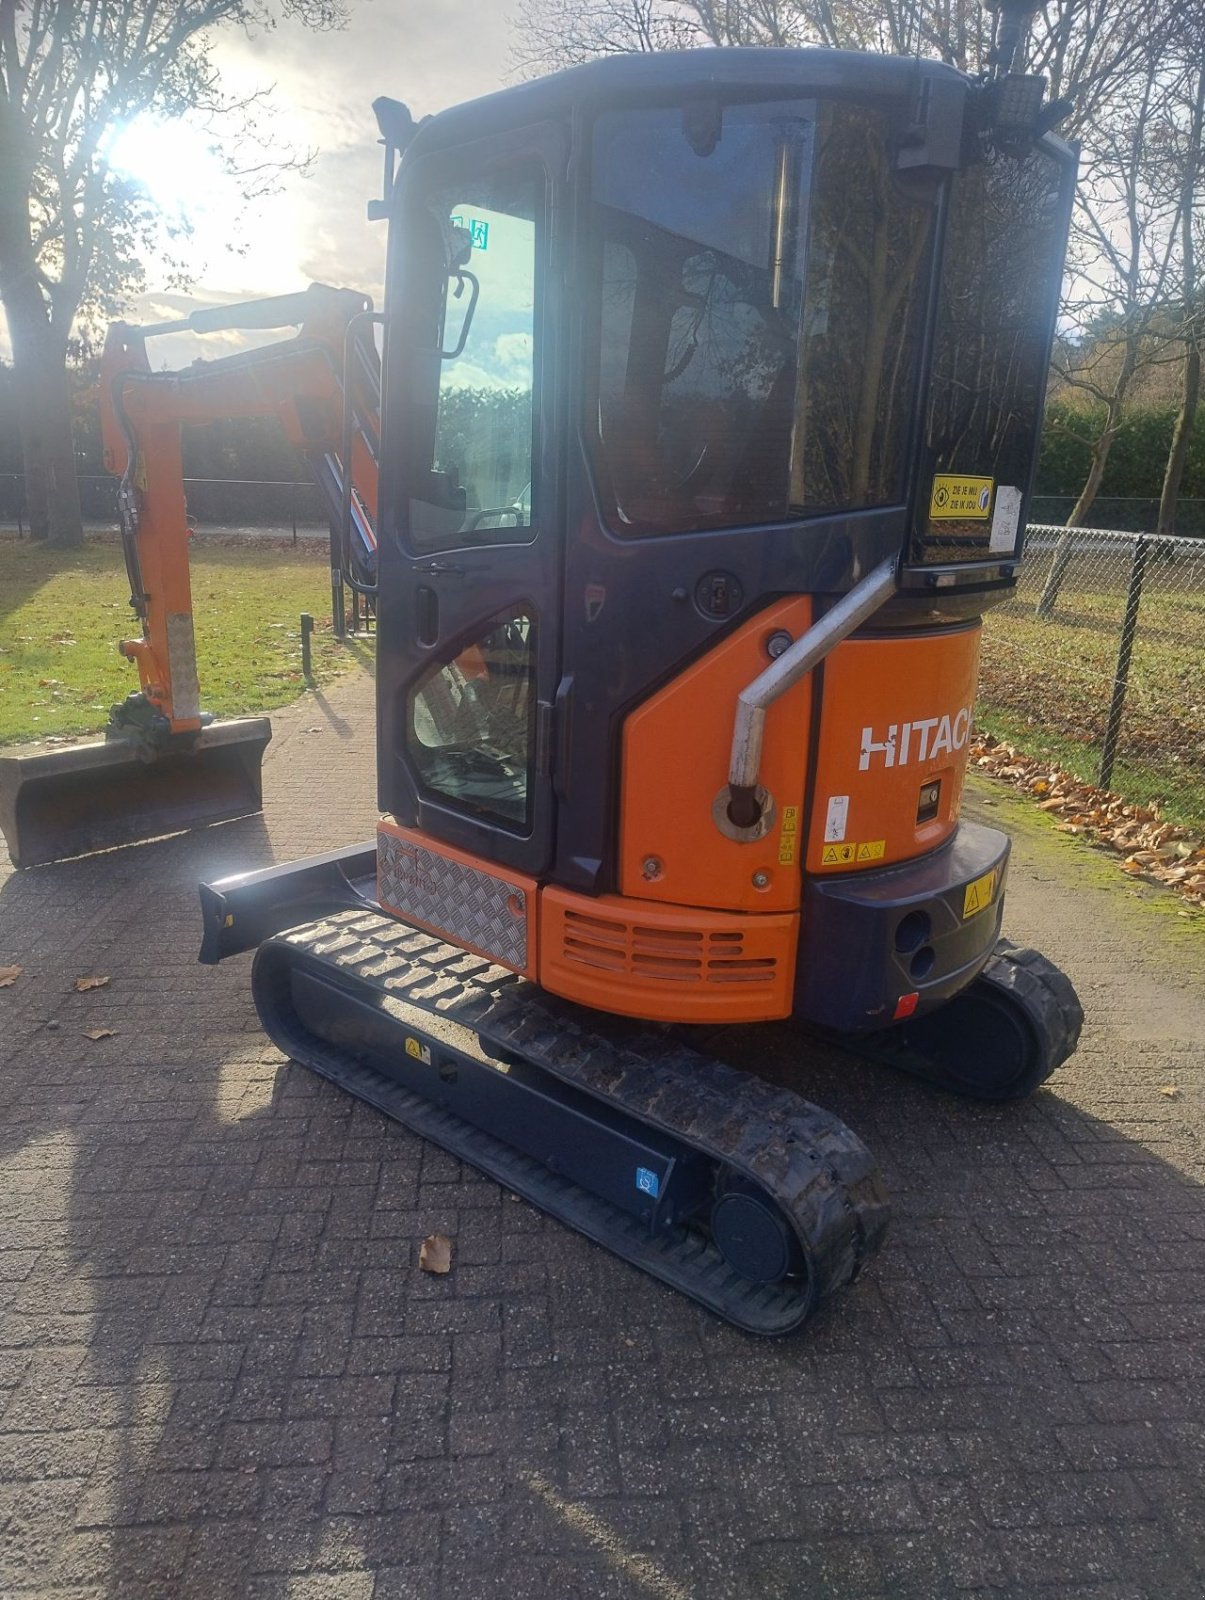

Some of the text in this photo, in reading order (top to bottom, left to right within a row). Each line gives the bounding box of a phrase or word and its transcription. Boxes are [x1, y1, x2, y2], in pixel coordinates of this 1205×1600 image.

[952, 485, 961, 495] ZIE
[961, 486, 968, 495] JE
[950, 500, 976, 509] ZIE IK JOU
